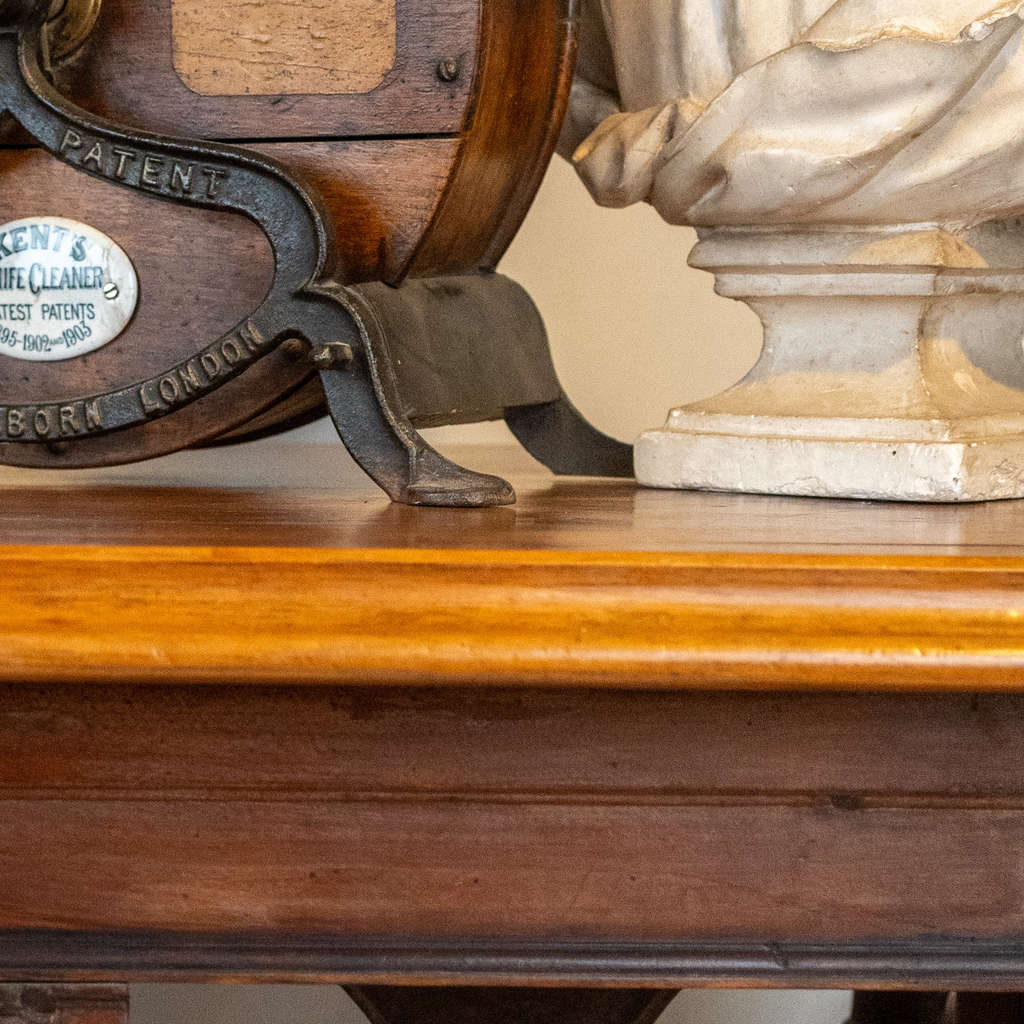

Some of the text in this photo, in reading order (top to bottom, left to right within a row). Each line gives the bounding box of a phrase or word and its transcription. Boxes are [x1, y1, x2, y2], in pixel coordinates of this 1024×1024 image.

[59, 129, 225, 199] PATENT
[28, 262, 104, 295] CLEANER
[41, 303, 96, 321] PATENTS
[139, 320, 264, 414] LONDON
